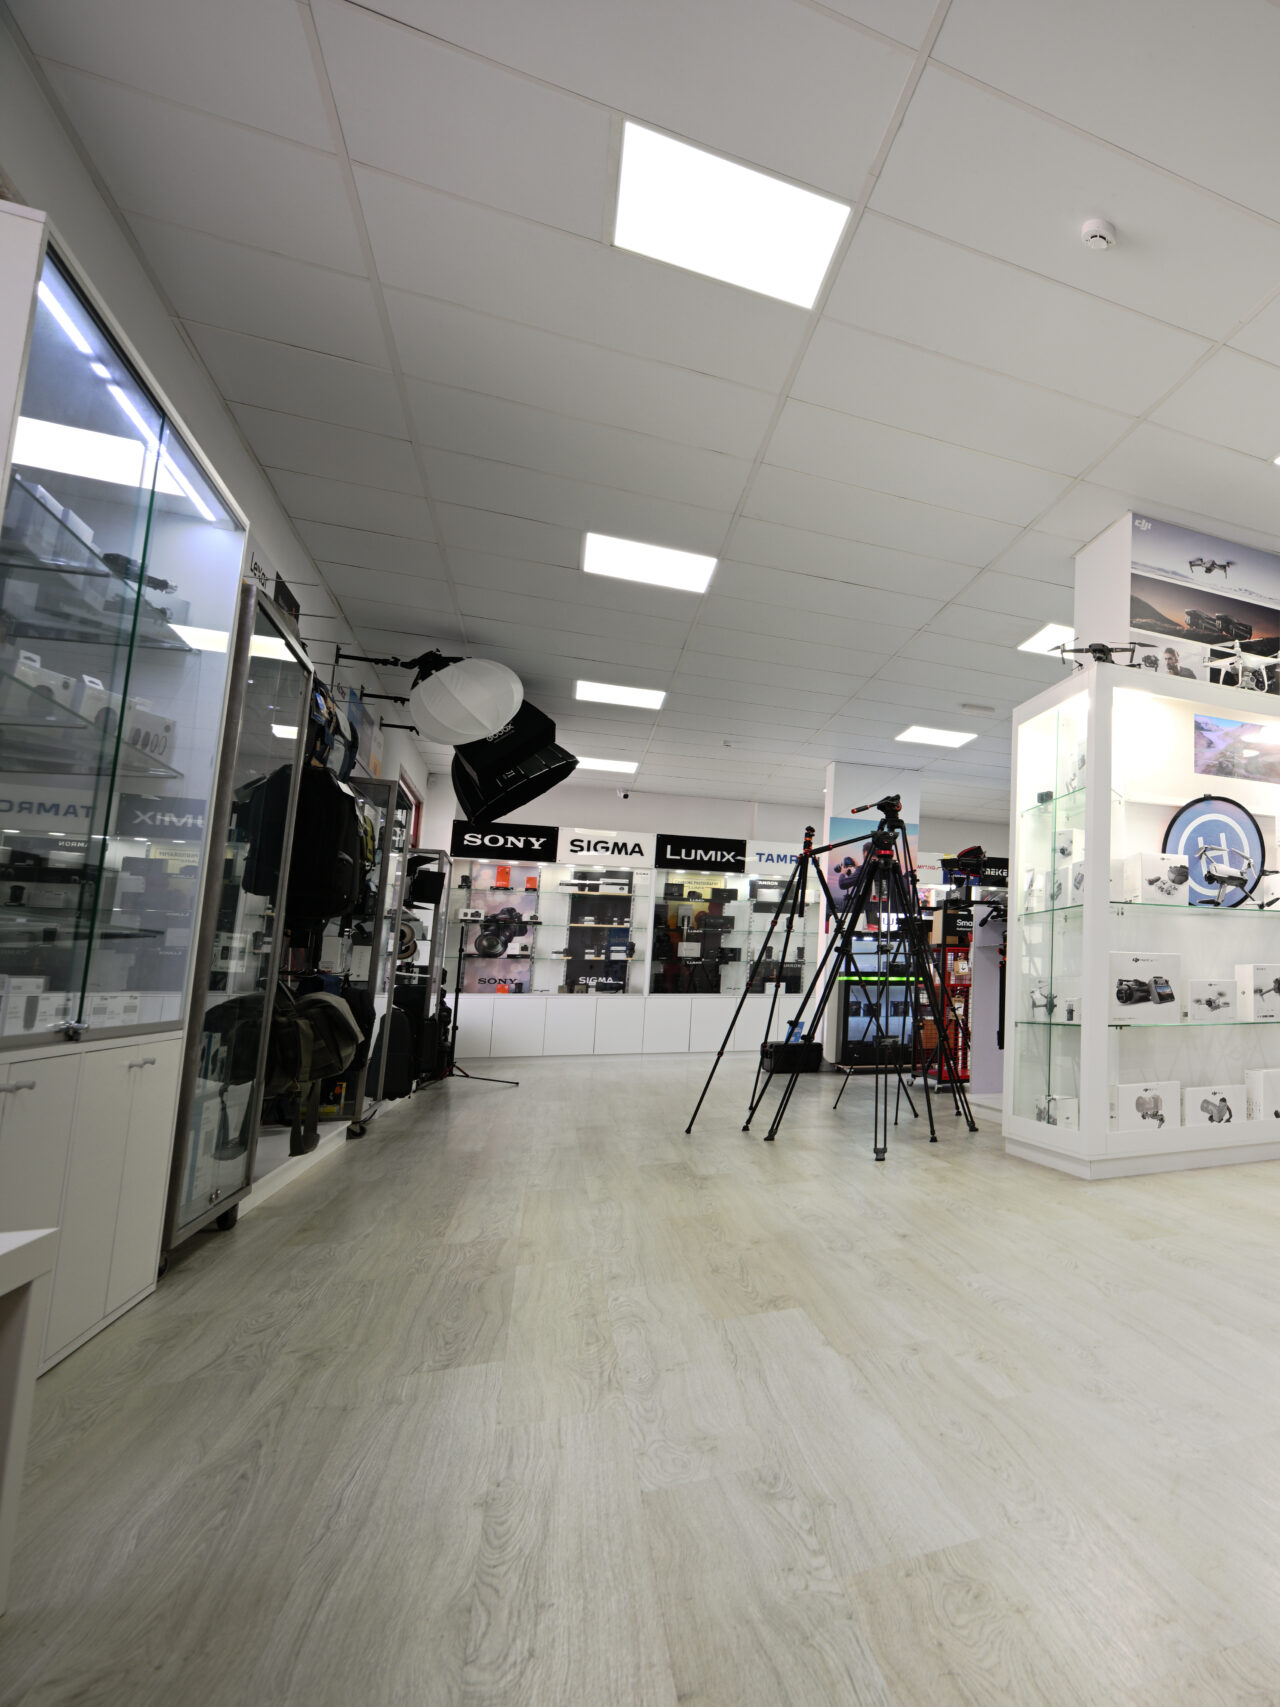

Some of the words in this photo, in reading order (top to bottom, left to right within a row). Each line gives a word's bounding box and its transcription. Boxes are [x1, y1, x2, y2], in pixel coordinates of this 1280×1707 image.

[463, 833, 547, 850] SONY
[569, 838, 645, 857] SIGMA
[666, 844, 736, 863] LUMIX
[477, 977, 518, 985] SONY
[578, 976, 614, 985] SIGMA
